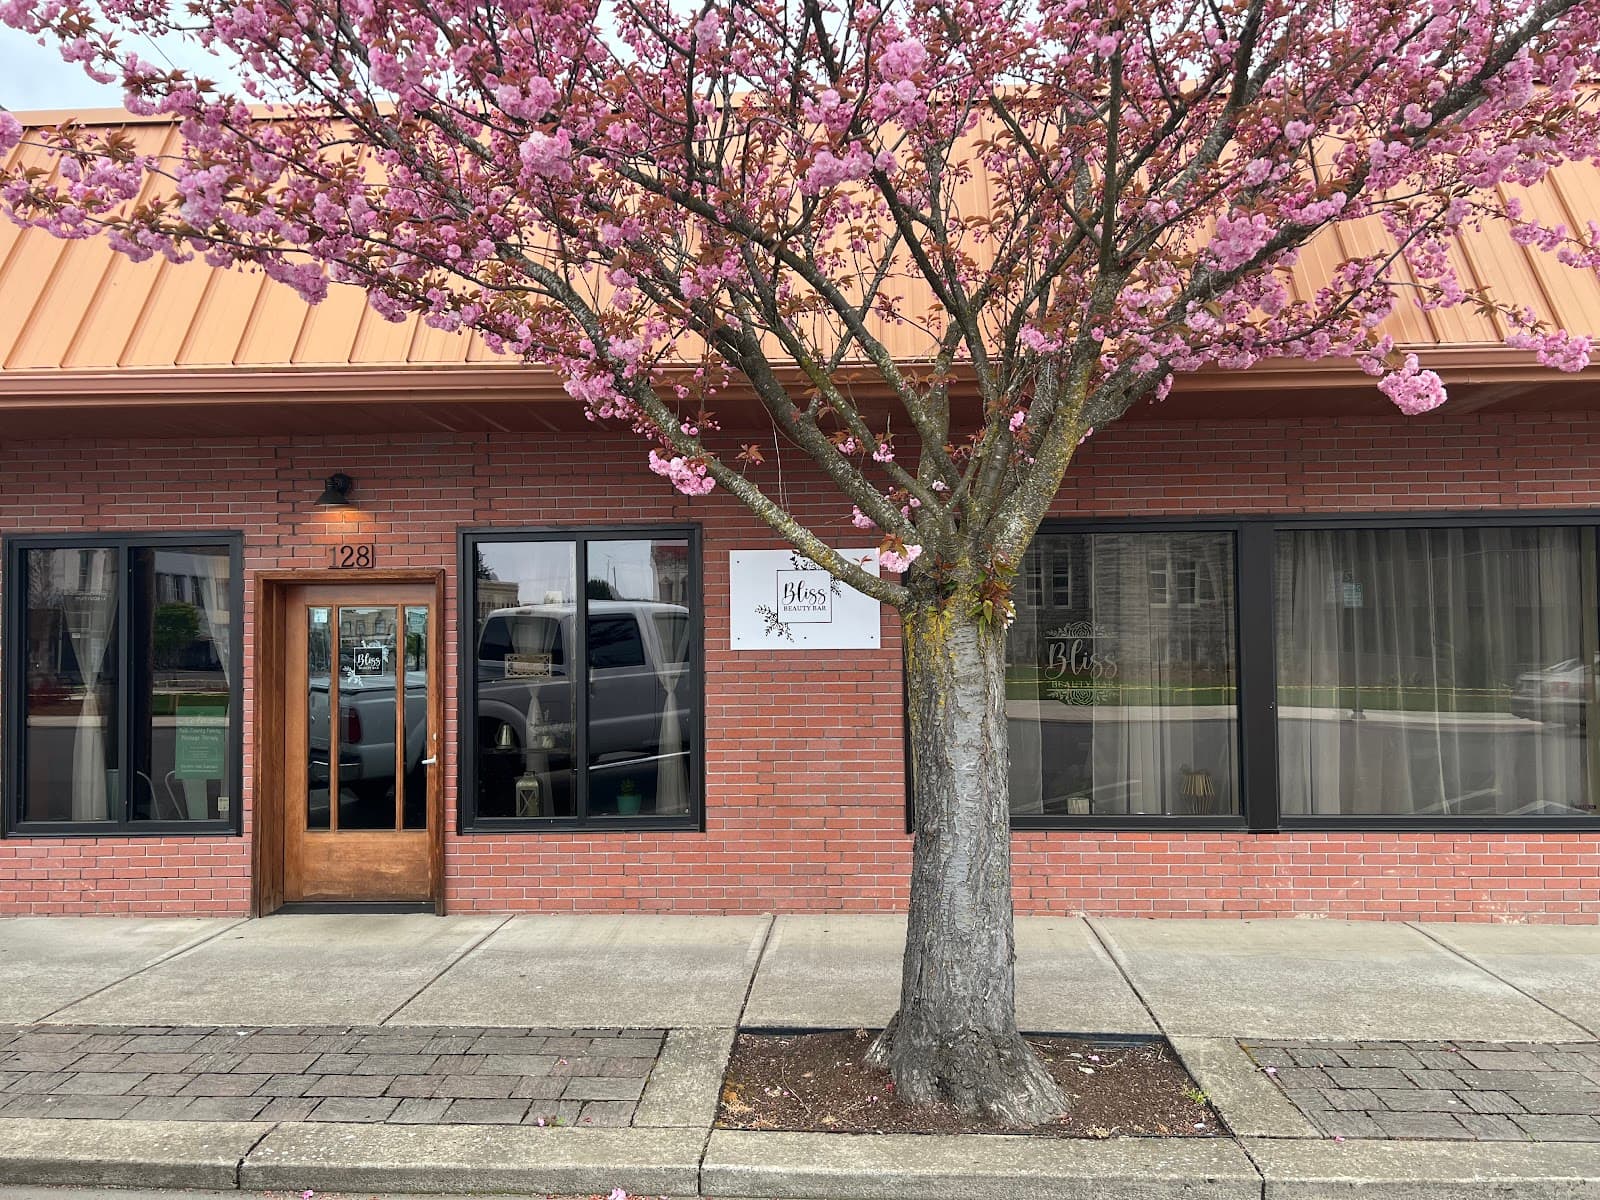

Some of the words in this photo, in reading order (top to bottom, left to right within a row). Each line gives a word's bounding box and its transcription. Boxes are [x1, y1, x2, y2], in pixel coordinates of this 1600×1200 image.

[329, 546, 370, 567] 128
[781, 580, 827, 605] Bliss
[356, 653, 381, 667] Bliss
[1044, 639, 1118, 680] Bliss
